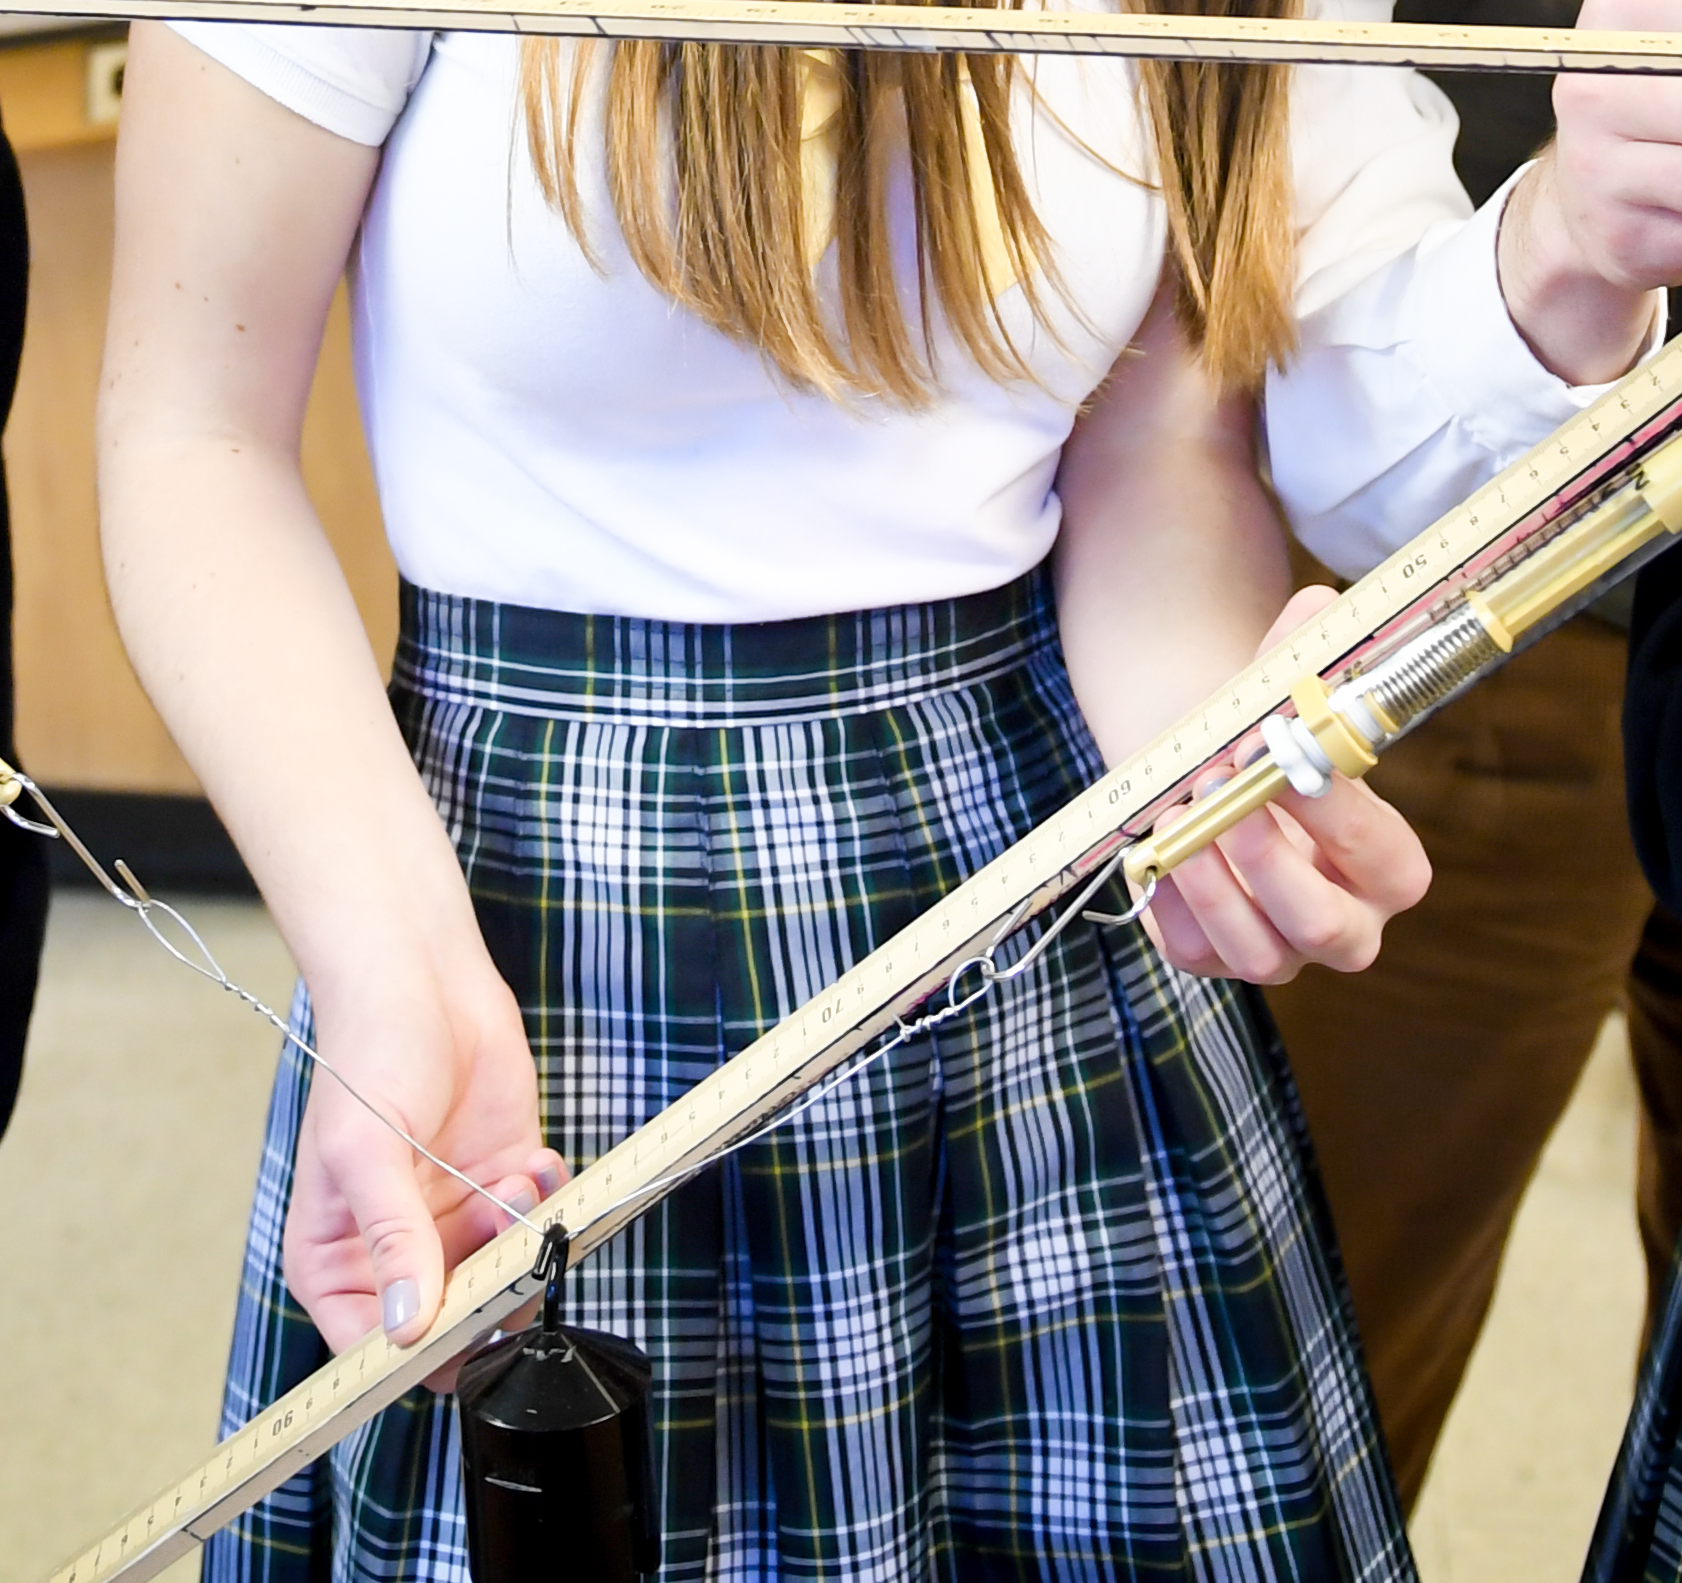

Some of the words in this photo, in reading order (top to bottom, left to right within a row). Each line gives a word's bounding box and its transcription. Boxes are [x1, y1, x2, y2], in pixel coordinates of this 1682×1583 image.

[1402, 554, 1428, 578] 50
[1108, 779, 1132, 805] 60
[822, 999, 844, 1024] 70
[272, 1411, 293, 1437] 90
